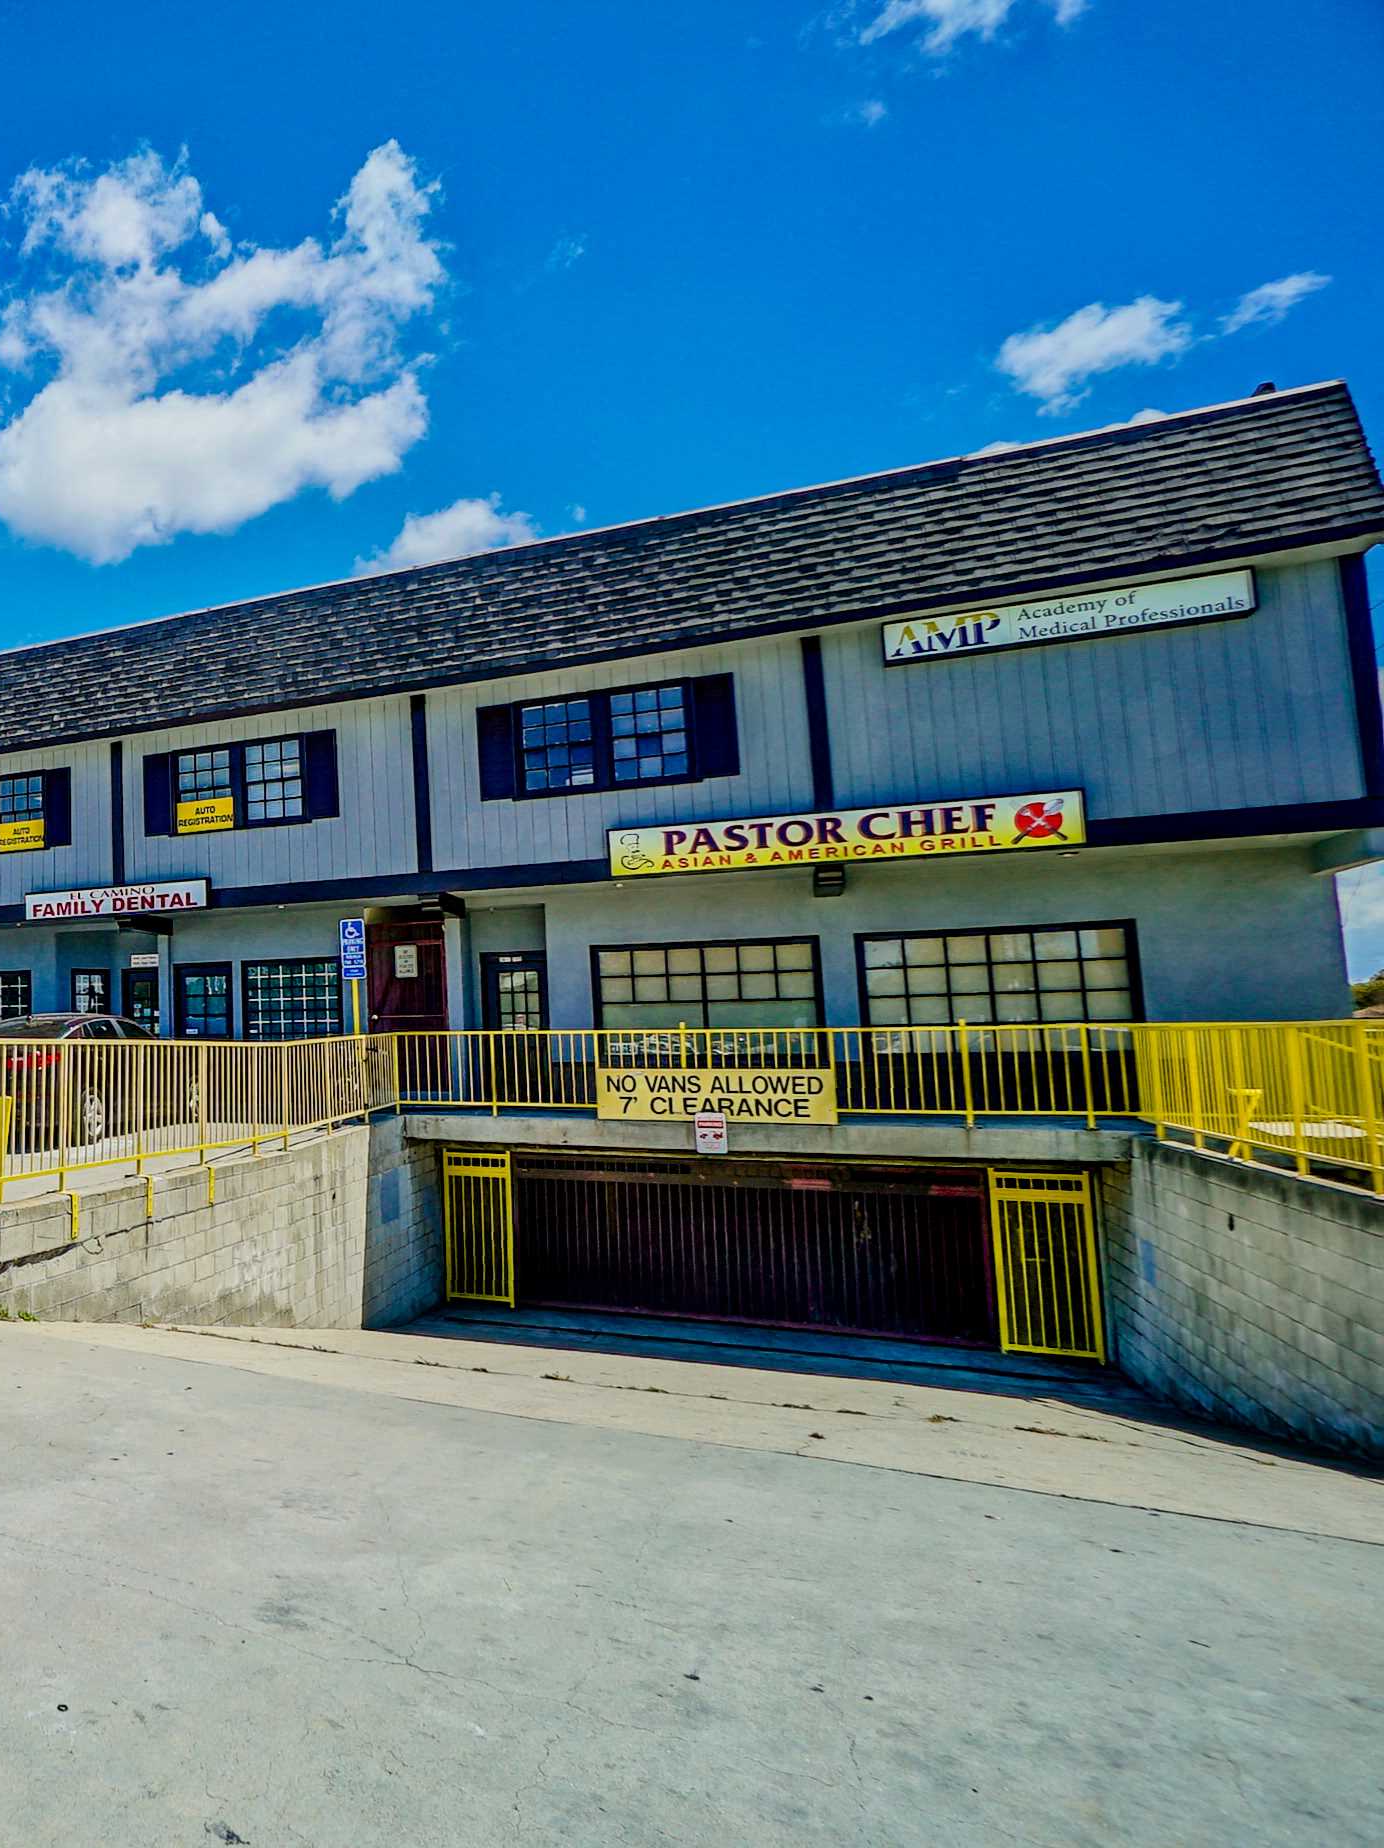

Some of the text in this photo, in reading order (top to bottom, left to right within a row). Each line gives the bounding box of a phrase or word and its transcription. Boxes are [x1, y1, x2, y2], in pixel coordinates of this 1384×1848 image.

[1017, 591, 1136, 621] Academy of
[1018, 595, 1245, 640] Medical Professionals
[892, 611, 1001, 657] AMP
[178, 814, 233, 827] REGISTRATION
[195, 806, 216, 816] AUTO
[13, 827, 30, 836] AUTO
[661, 803, 996, 856] PASTOR CHEF
[661, 835, 1003, 870] ASIAN & AMERICAN GRILL
[33, 892, 198, 917] FAMILY DENTAL
[70, 886, 155, 900] EL CAMINO
[606, 1074, 824, 1095] NO VANS ALLOWED
[619, 1096, 811, 1118] 7' CLEARANCE
